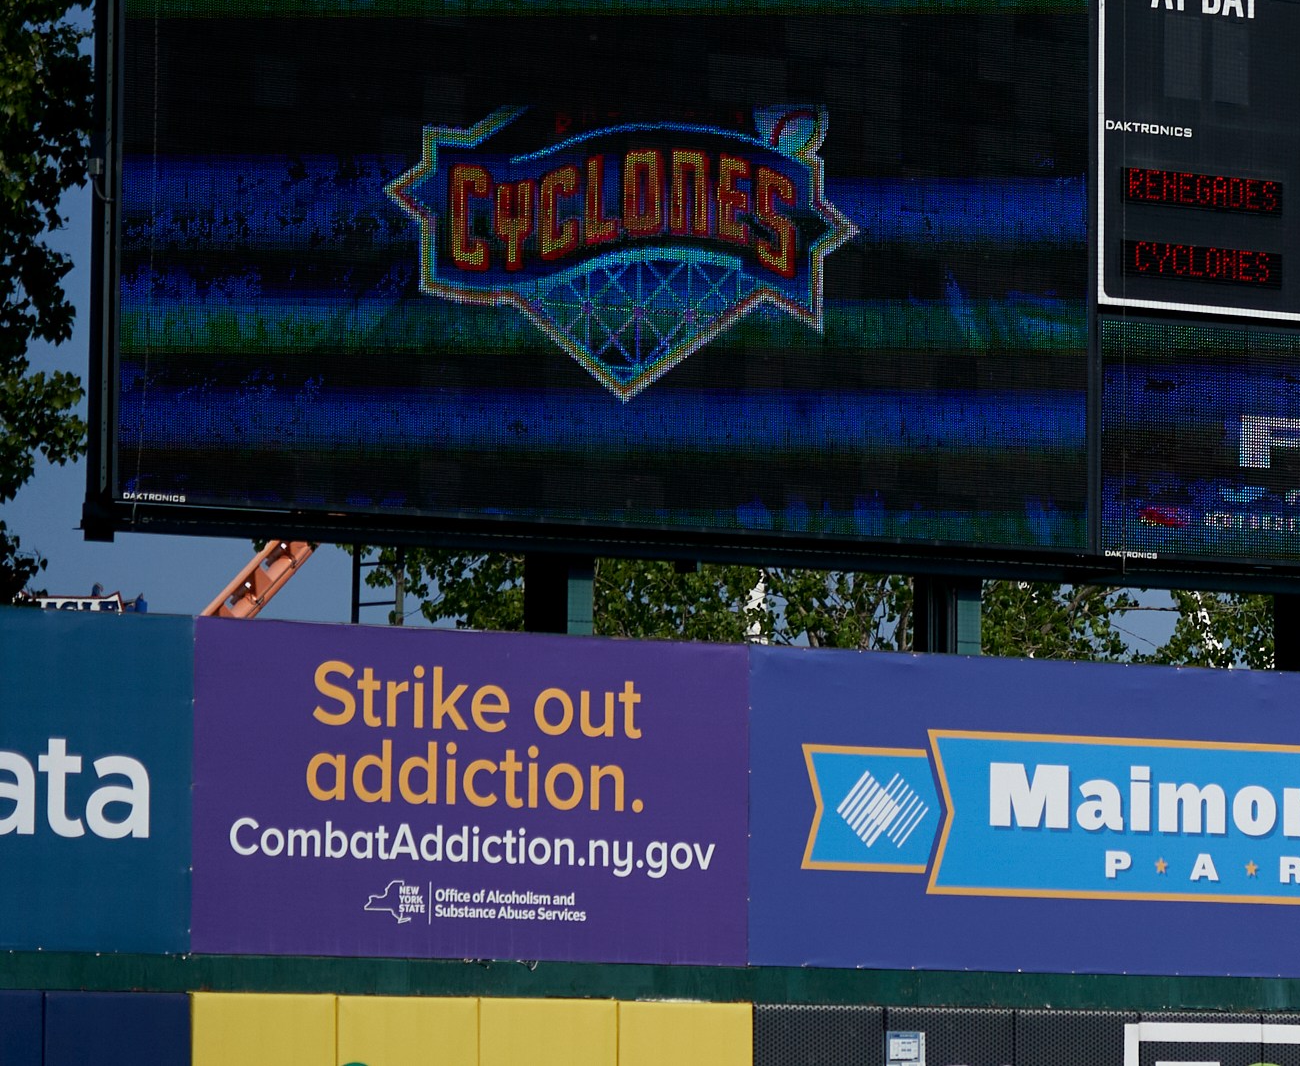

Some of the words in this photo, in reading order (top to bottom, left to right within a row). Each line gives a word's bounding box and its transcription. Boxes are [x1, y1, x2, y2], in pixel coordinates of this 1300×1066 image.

[1105, 120, 1192, 138] DAKTRONICS
[1128, 169, 1277, 211] RENEGADES
[447, 147, 797, 277] CYCLONES
[1134, 241, 1270, 283] CYCLONES
[122, 492, 186, 503] DAKTRONICS
[1105, 550, 1157, 559] DAKTRONICS
[312, 659, 510, 734] Strike
[534, 680, 642, 739] out
[306, 739, 644, 812] addiction.
[229, 816, 716, 880] CombatAddiction.ny.gov
[399, 895, 423, 904] YORK
[400, 886, 419, 895] NEW
[435, 889, 471, 903] Office
[472, 890, 485, 904] of
[486, 890, 551, 905] Alcoholism
[553, 893, 575, 906] and
[399, 904, 425, 913] STATE
[435, 904, 498, 919] Substance
[498, 905, 535, 920] Abuse
[537, 907, 586, 922] Services
